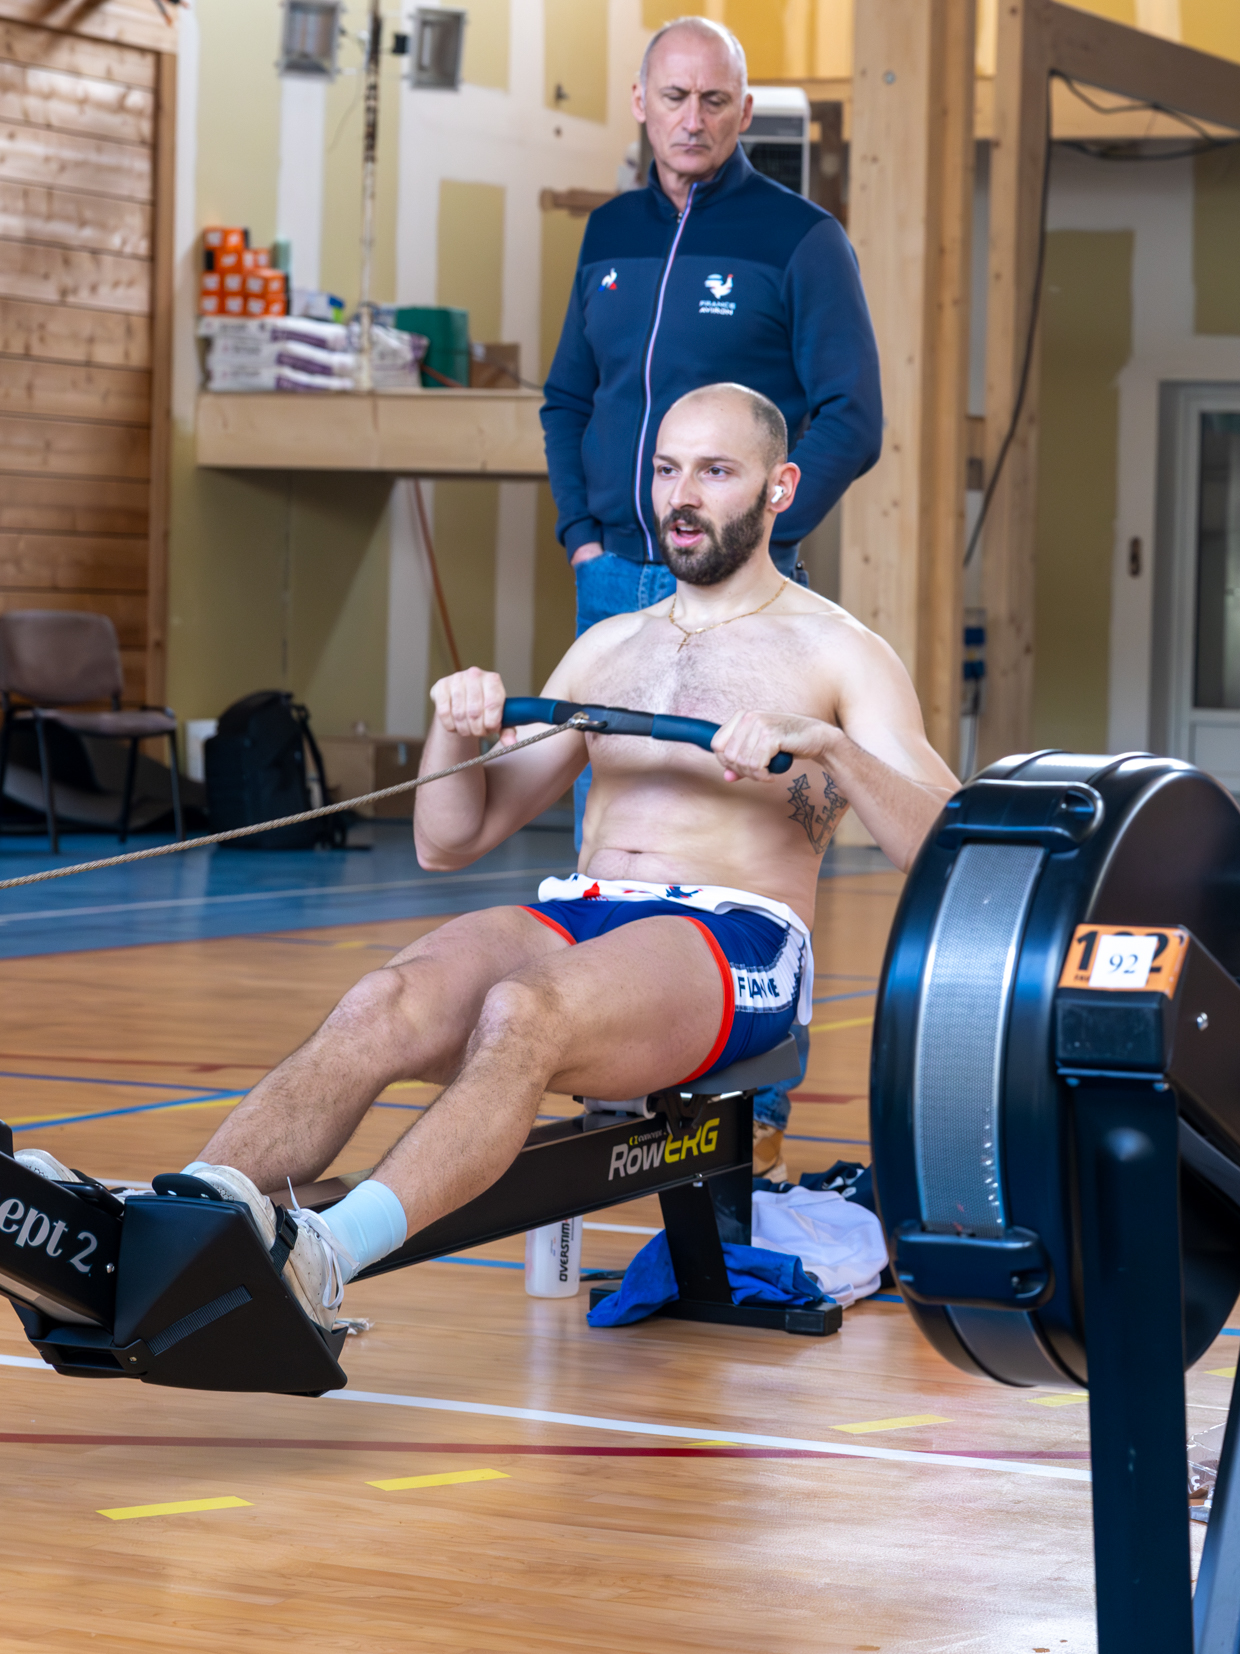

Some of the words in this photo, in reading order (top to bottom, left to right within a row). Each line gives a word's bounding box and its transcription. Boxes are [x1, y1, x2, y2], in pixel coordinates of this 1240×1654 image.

[699, 300, 736, 310] FRANCE
[699, 306, 734, 316] AVIRON
[1077, 930, 1169, 973] 12
[1108, 953, 1139, 974] 92
[69, 1231, 98, 1275] 2
